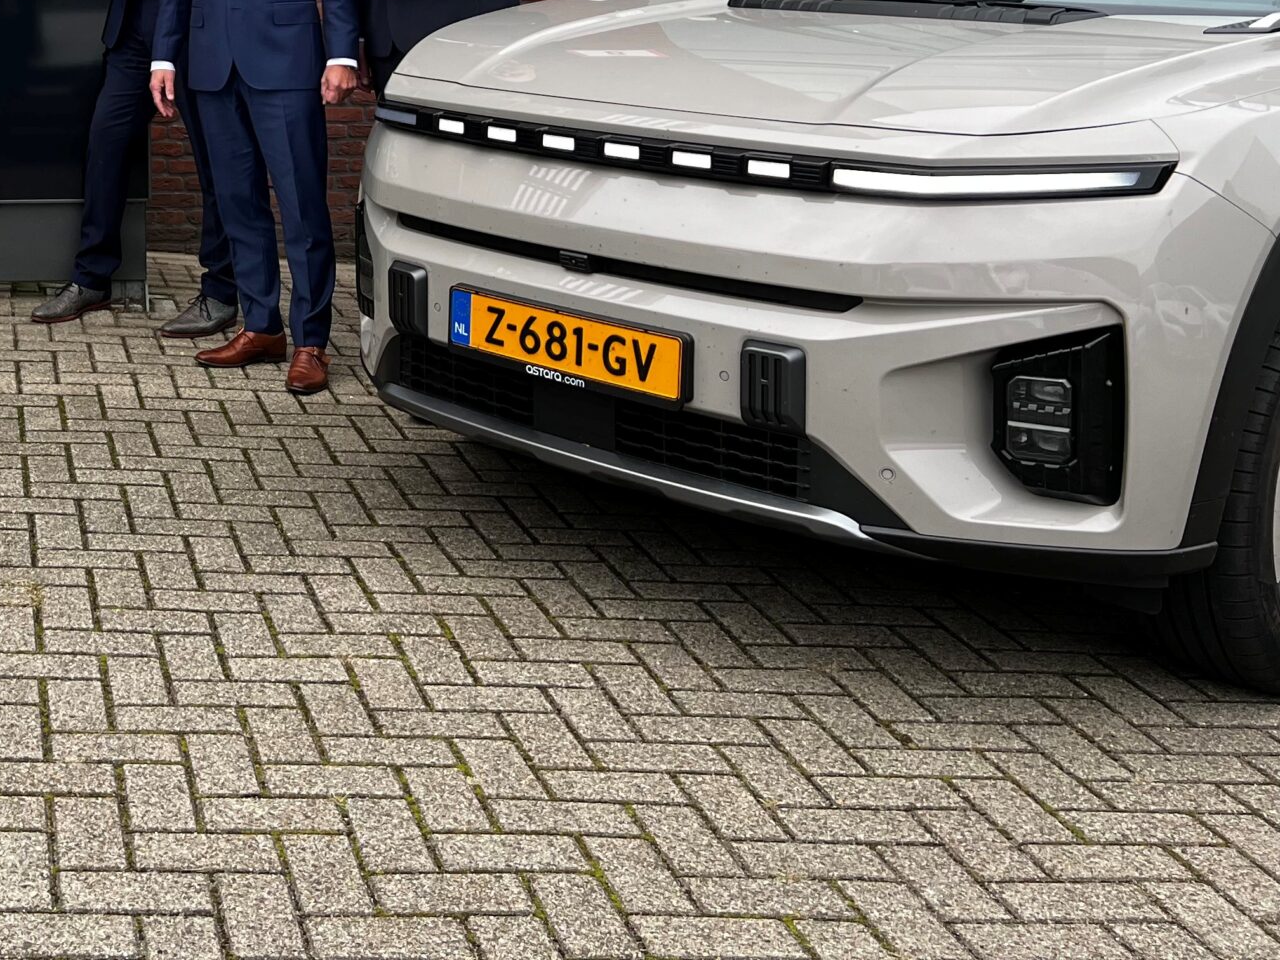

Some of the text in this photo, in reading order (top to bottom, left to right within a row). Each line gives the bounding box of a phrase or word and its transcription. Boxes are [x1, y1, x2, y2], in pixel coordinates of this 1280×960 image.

[454, 322, 468, 336] NL
[485, 306, 657, 382] Z-681-GV
[525, 364, 585, 388] astara.com
